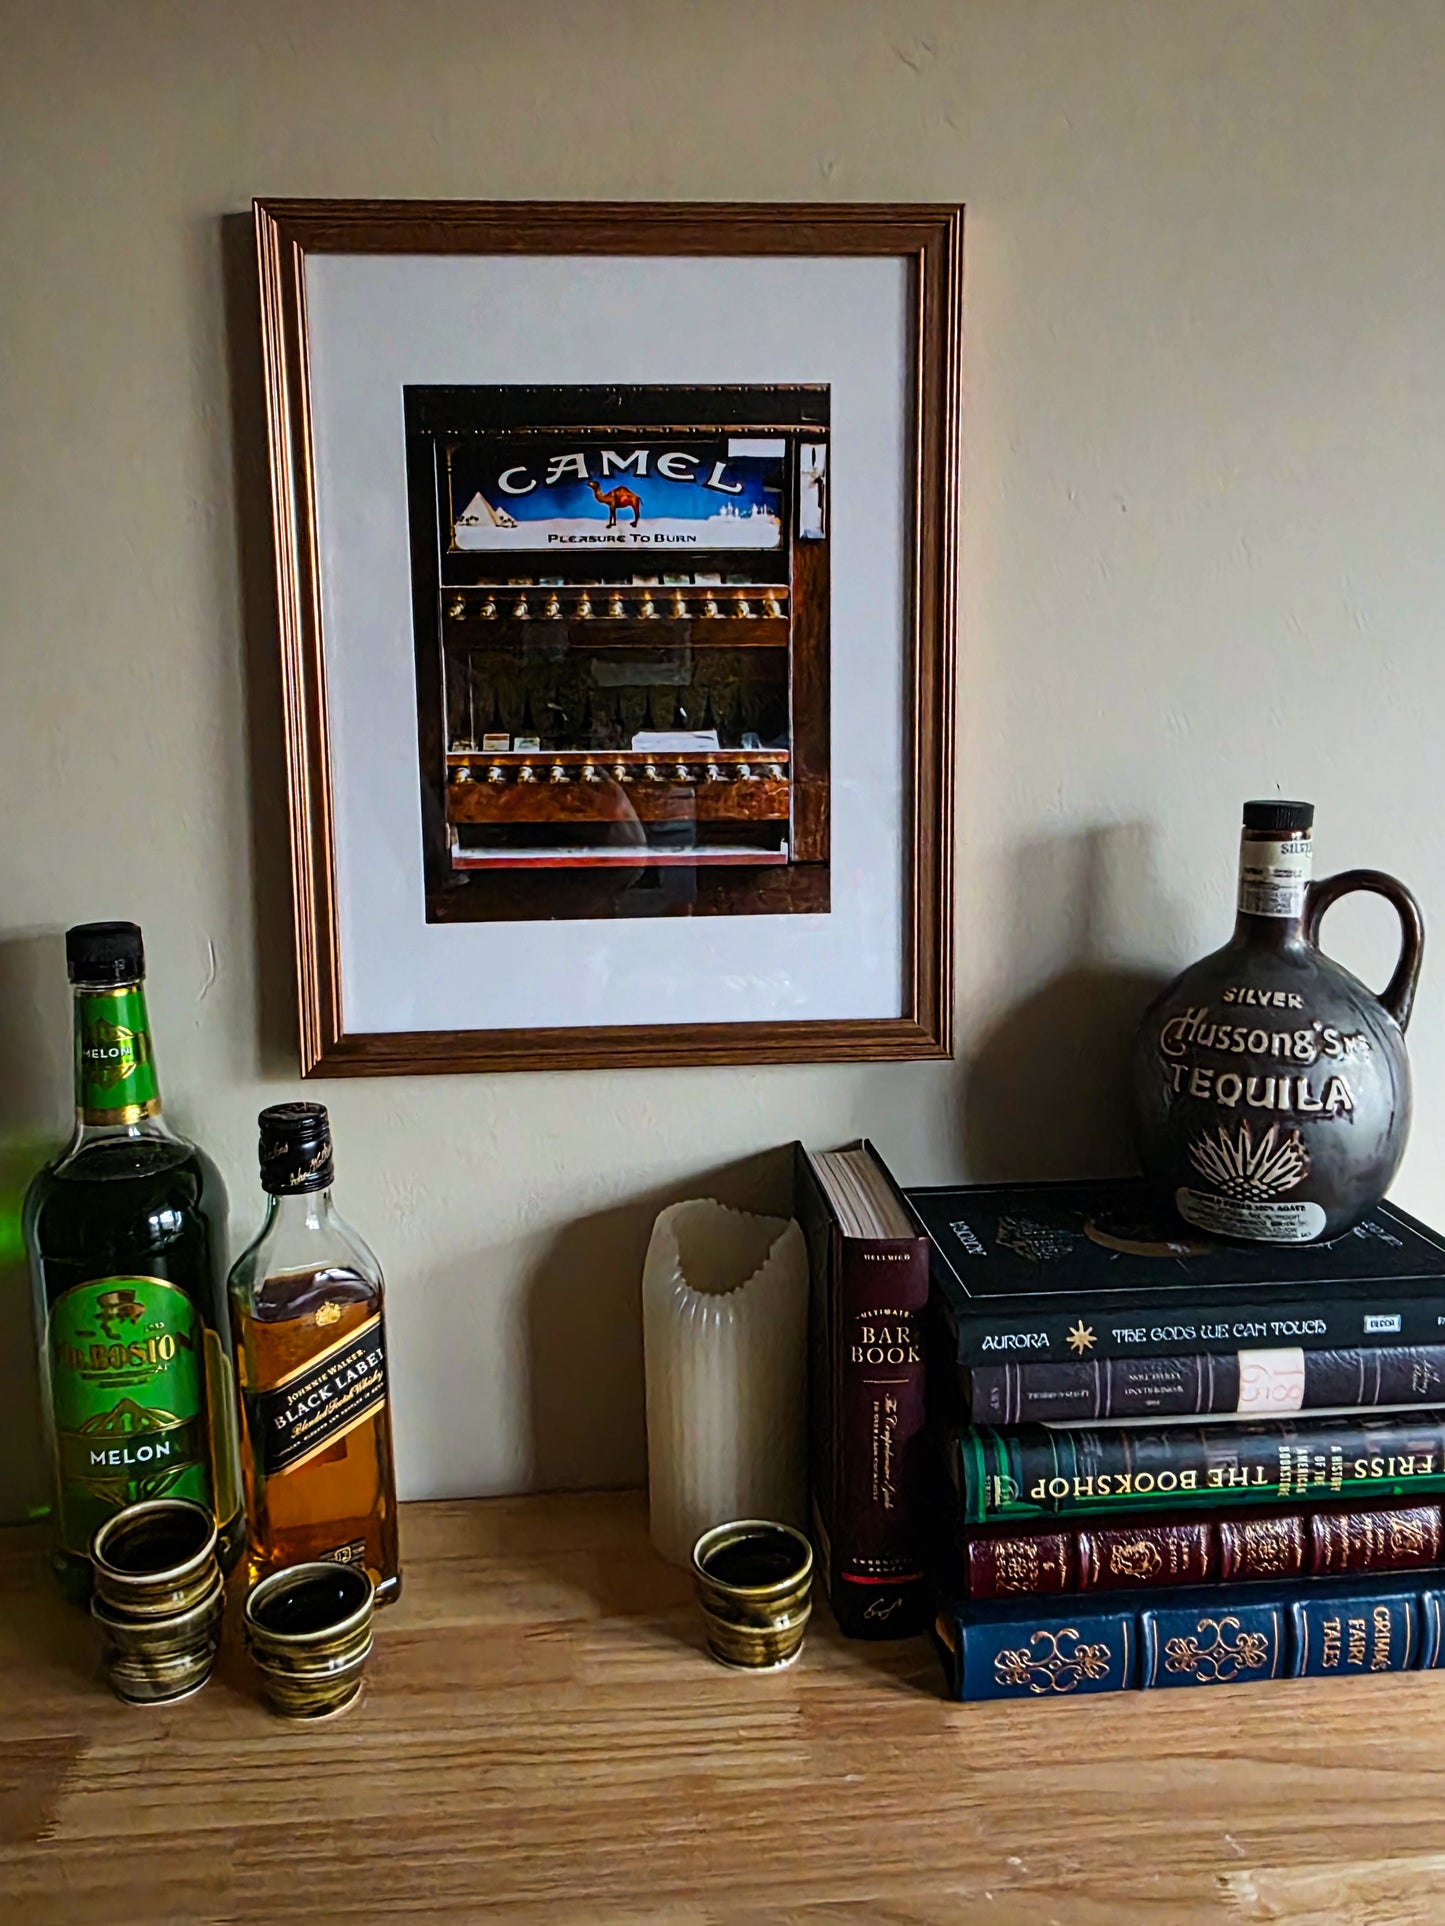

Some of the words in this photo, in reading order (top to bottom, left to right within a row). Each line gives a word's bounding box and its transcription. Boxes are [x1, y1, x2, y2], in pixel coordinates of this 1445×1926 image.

[498, 450, 743, 494] CAMEL
[548, 534, 626, 544] PLEASURE
[630, 534, 650, 544] TO
[654, 534, 697, 543] BURN
[1223, 987, 1305, 1009] SILVER
[83, 1046, 131, 1059] MELON
[1170, 1063, 1352, 1112] TEQUILA
[861, 1326, 911, 1344] BAR
[981, 1332, 1050, 1351] AURORA
[1112, 1327, 1147, 1344] THE
[1150, 1325, 1197, 1342] GODS
[1200, 1324, 1229, 1340] WE
[1232, 1321, 1268, 1338] CAN
[1270, 1319, 1327, 1336] TOUCH
[851, 1344, 921, 1364] BOOK
[287, 1374, 329, 1406] JOHNNIE
[273, 1385, 333, 1430] BLACK
[90, 1441, 171, 1465] MELON
[1313, 1455, 1326, 1468] OF
[1208, 1465, 1268, 1487] THE
[1277, 1445, 1291, 1497] BOOKSTORE
[1296, 1448, 1309, 1494] AMERICAN
[1313, 1471, 1326, 1486] THE
[1329, 1455, 1344, 1492] HISTORY
[1354, 1454, 1434, 1479] FRISS
[1031, 1469, 1198, 1499] BOOKSHOP
[1322, 1616, 1342, 1668] TALES
[1347, 1618, 1366, 1666] FAIRY
